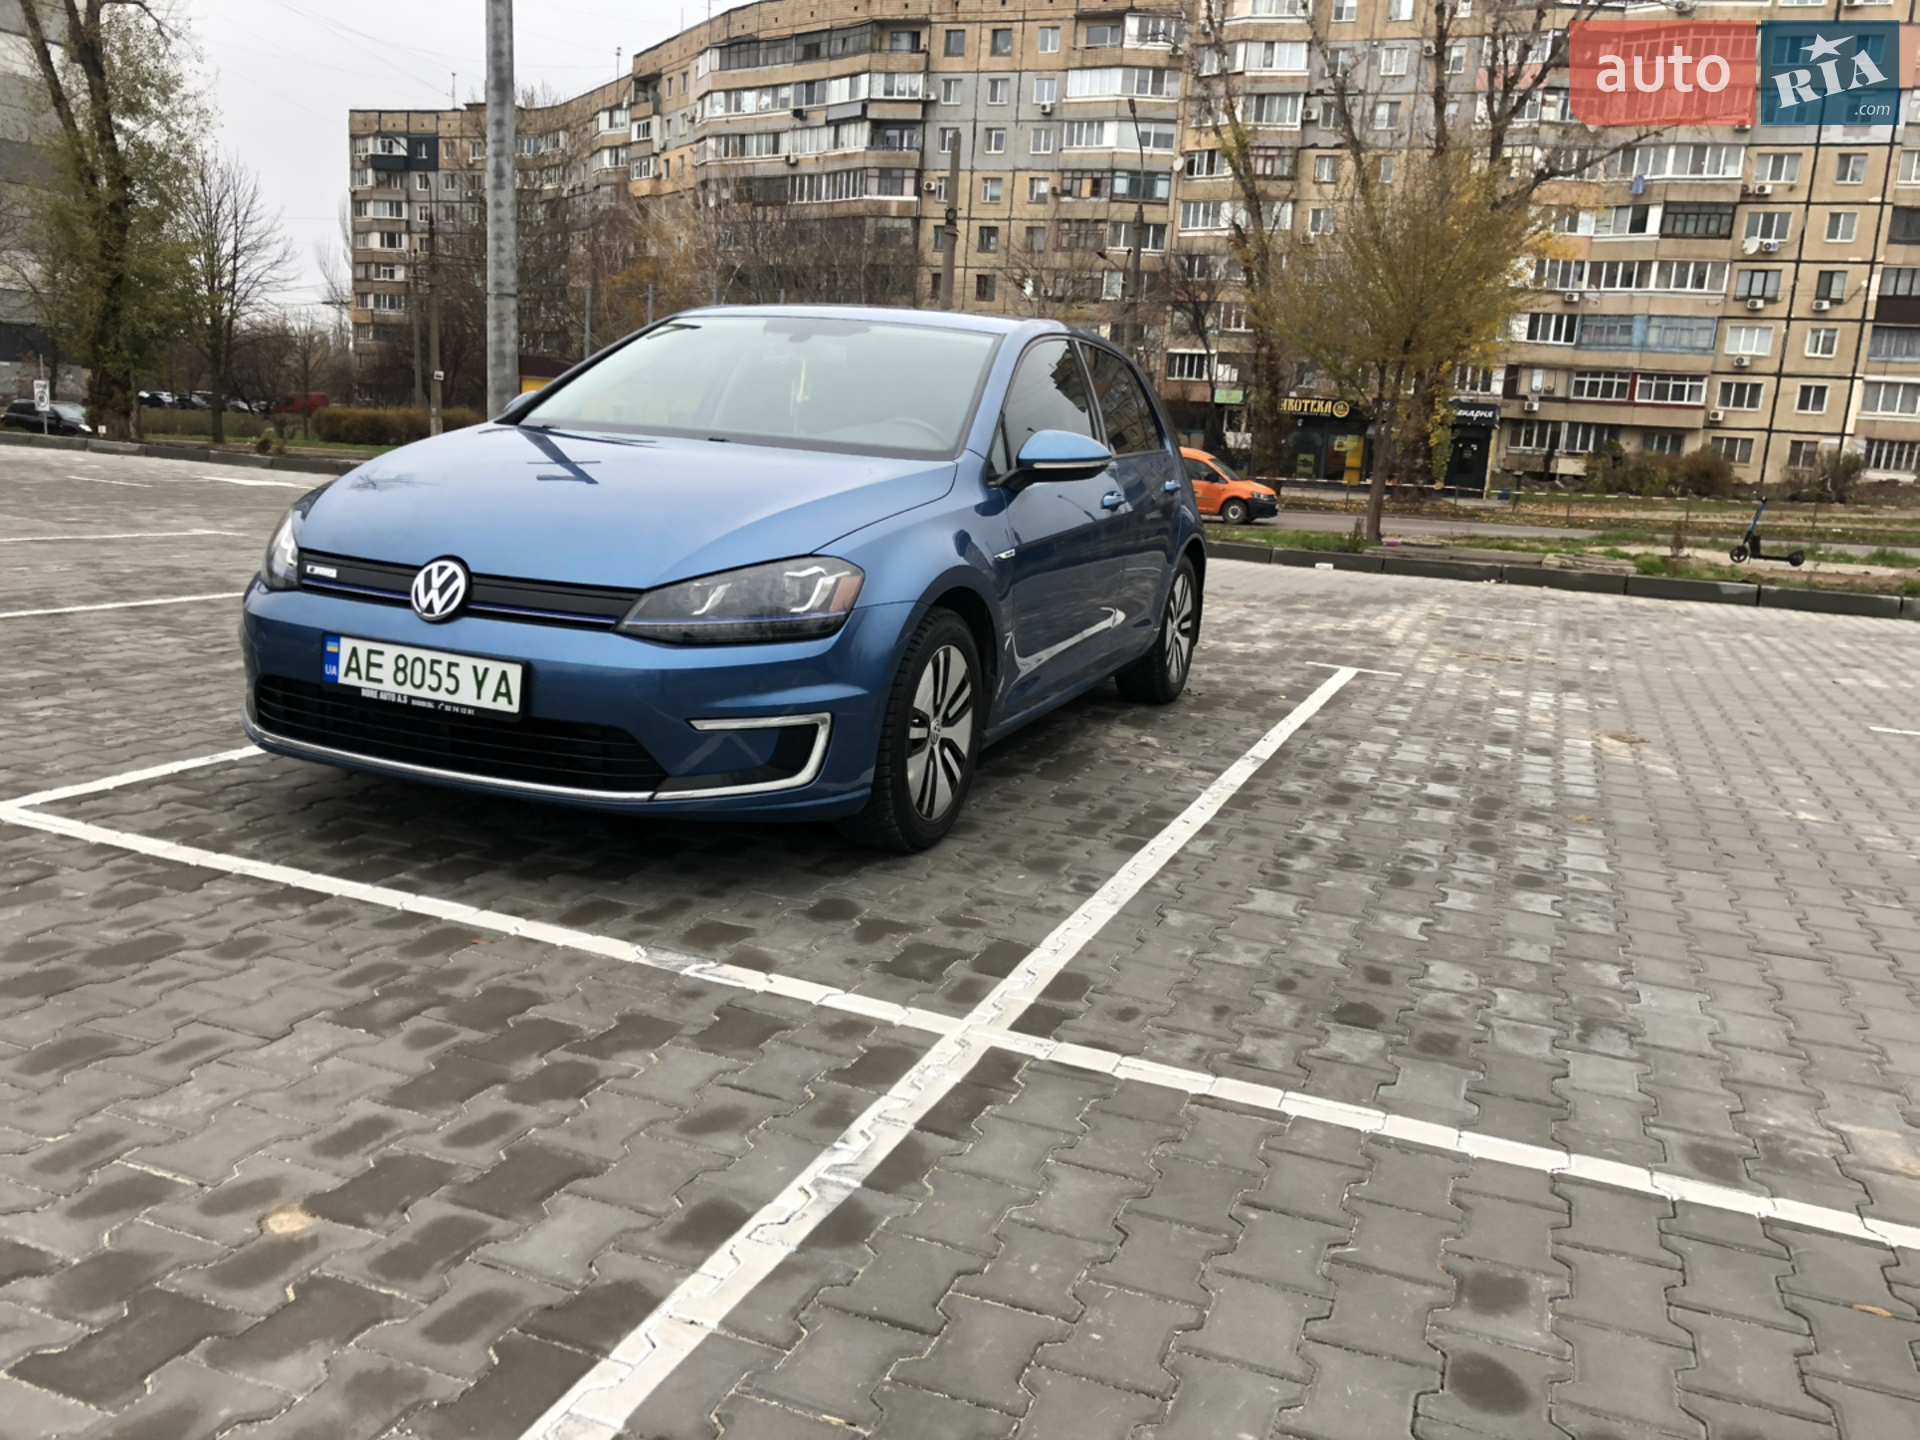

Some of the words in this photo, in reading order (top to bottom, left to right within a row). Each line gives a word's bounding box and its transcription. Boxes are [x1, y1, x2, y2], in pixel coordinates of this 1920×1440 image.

[1453, 408, 1494, 421] екарня
[325, 664, 338, 676] UA
[343, 646, 385, 684] AE
[393, 654, 460, 696] 8055
[472, 665, 514, 706] YA
